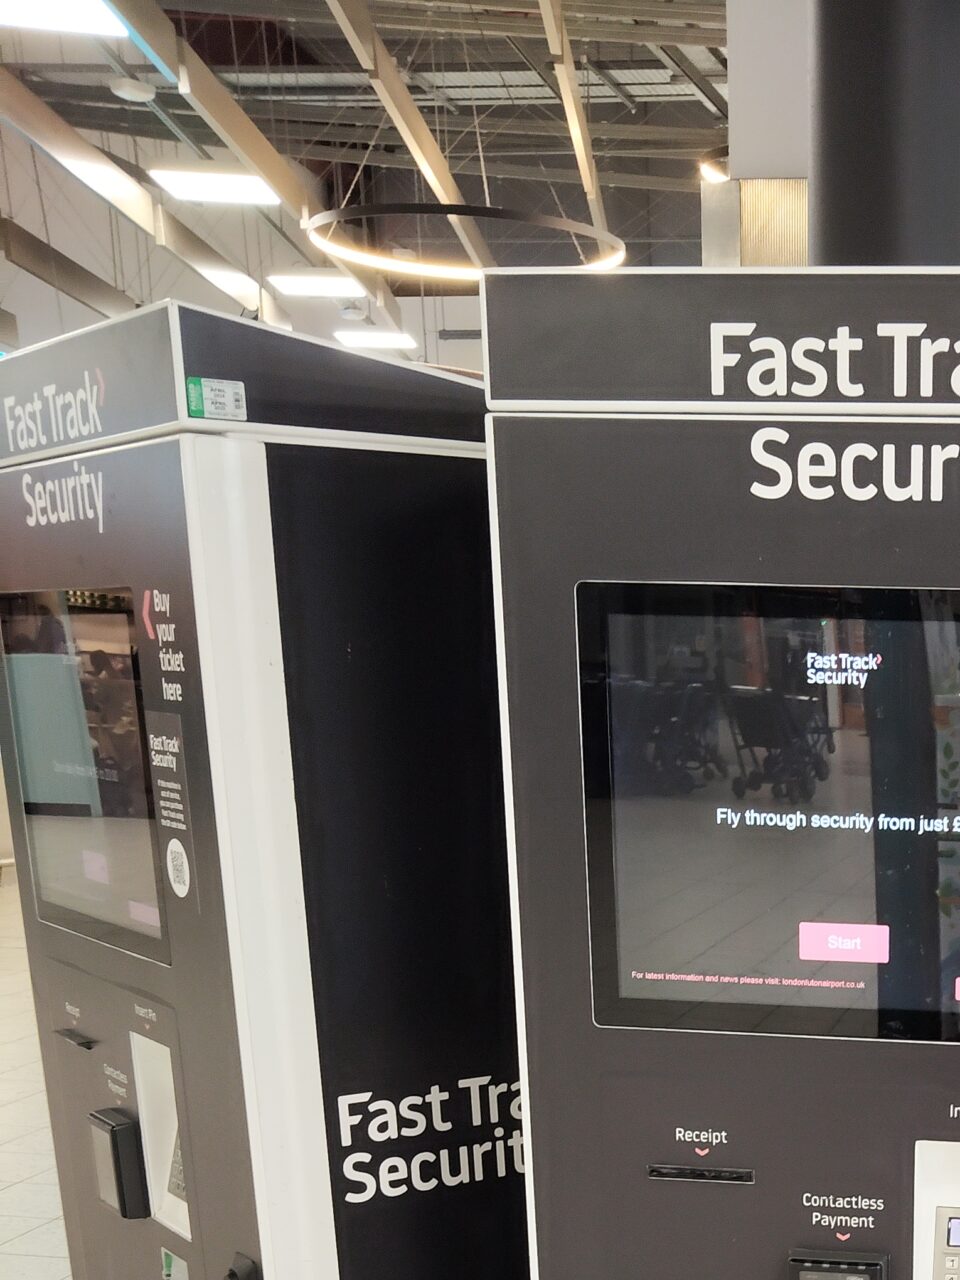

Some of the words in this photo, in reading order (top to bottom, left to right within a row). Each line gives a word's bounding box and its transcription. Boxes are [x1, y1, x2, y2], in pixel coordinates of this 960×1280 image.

[710, 322, 864, 397] Fast
[4, 391, 47, 452] Fast
[43, 370, 102, 442] Track
[22, 460, 104, 534] Security
[153, 589, 170, 617] Buy
[156, 623, 175, 647] your
[159, 648, 185, 672] ticket
[807, 652, 837, 669] Fast
[839, 653, 878, 670] Track
[162, 677, 182, 701] here
[806, 668, 868, 689] Security
[716, 808, 741, 828] Fly
[744, 810, 807, 831] through
[811, 813, 874, 833] security
[877, 813, 915, 831] from
[918, 815, 949, 835] just
[827, 935, 861, 950] Start
[631, 971, 643, 979] For
[645, 972, 664, 980] latest
[665, 972, 704, 982] information
[705, 974, 719, 982] and
[720, 976, 738, 984] news
[740, 976, 763, 985] please
[337, 1085, 452, 1147] Fast
[675, 1127, 728, 1146] Receipt
[342, 1127, 526, 1203] Securit
[802, 1193, 885, 1211] Contactless
[811, 1212, 875, 1230] Payment
